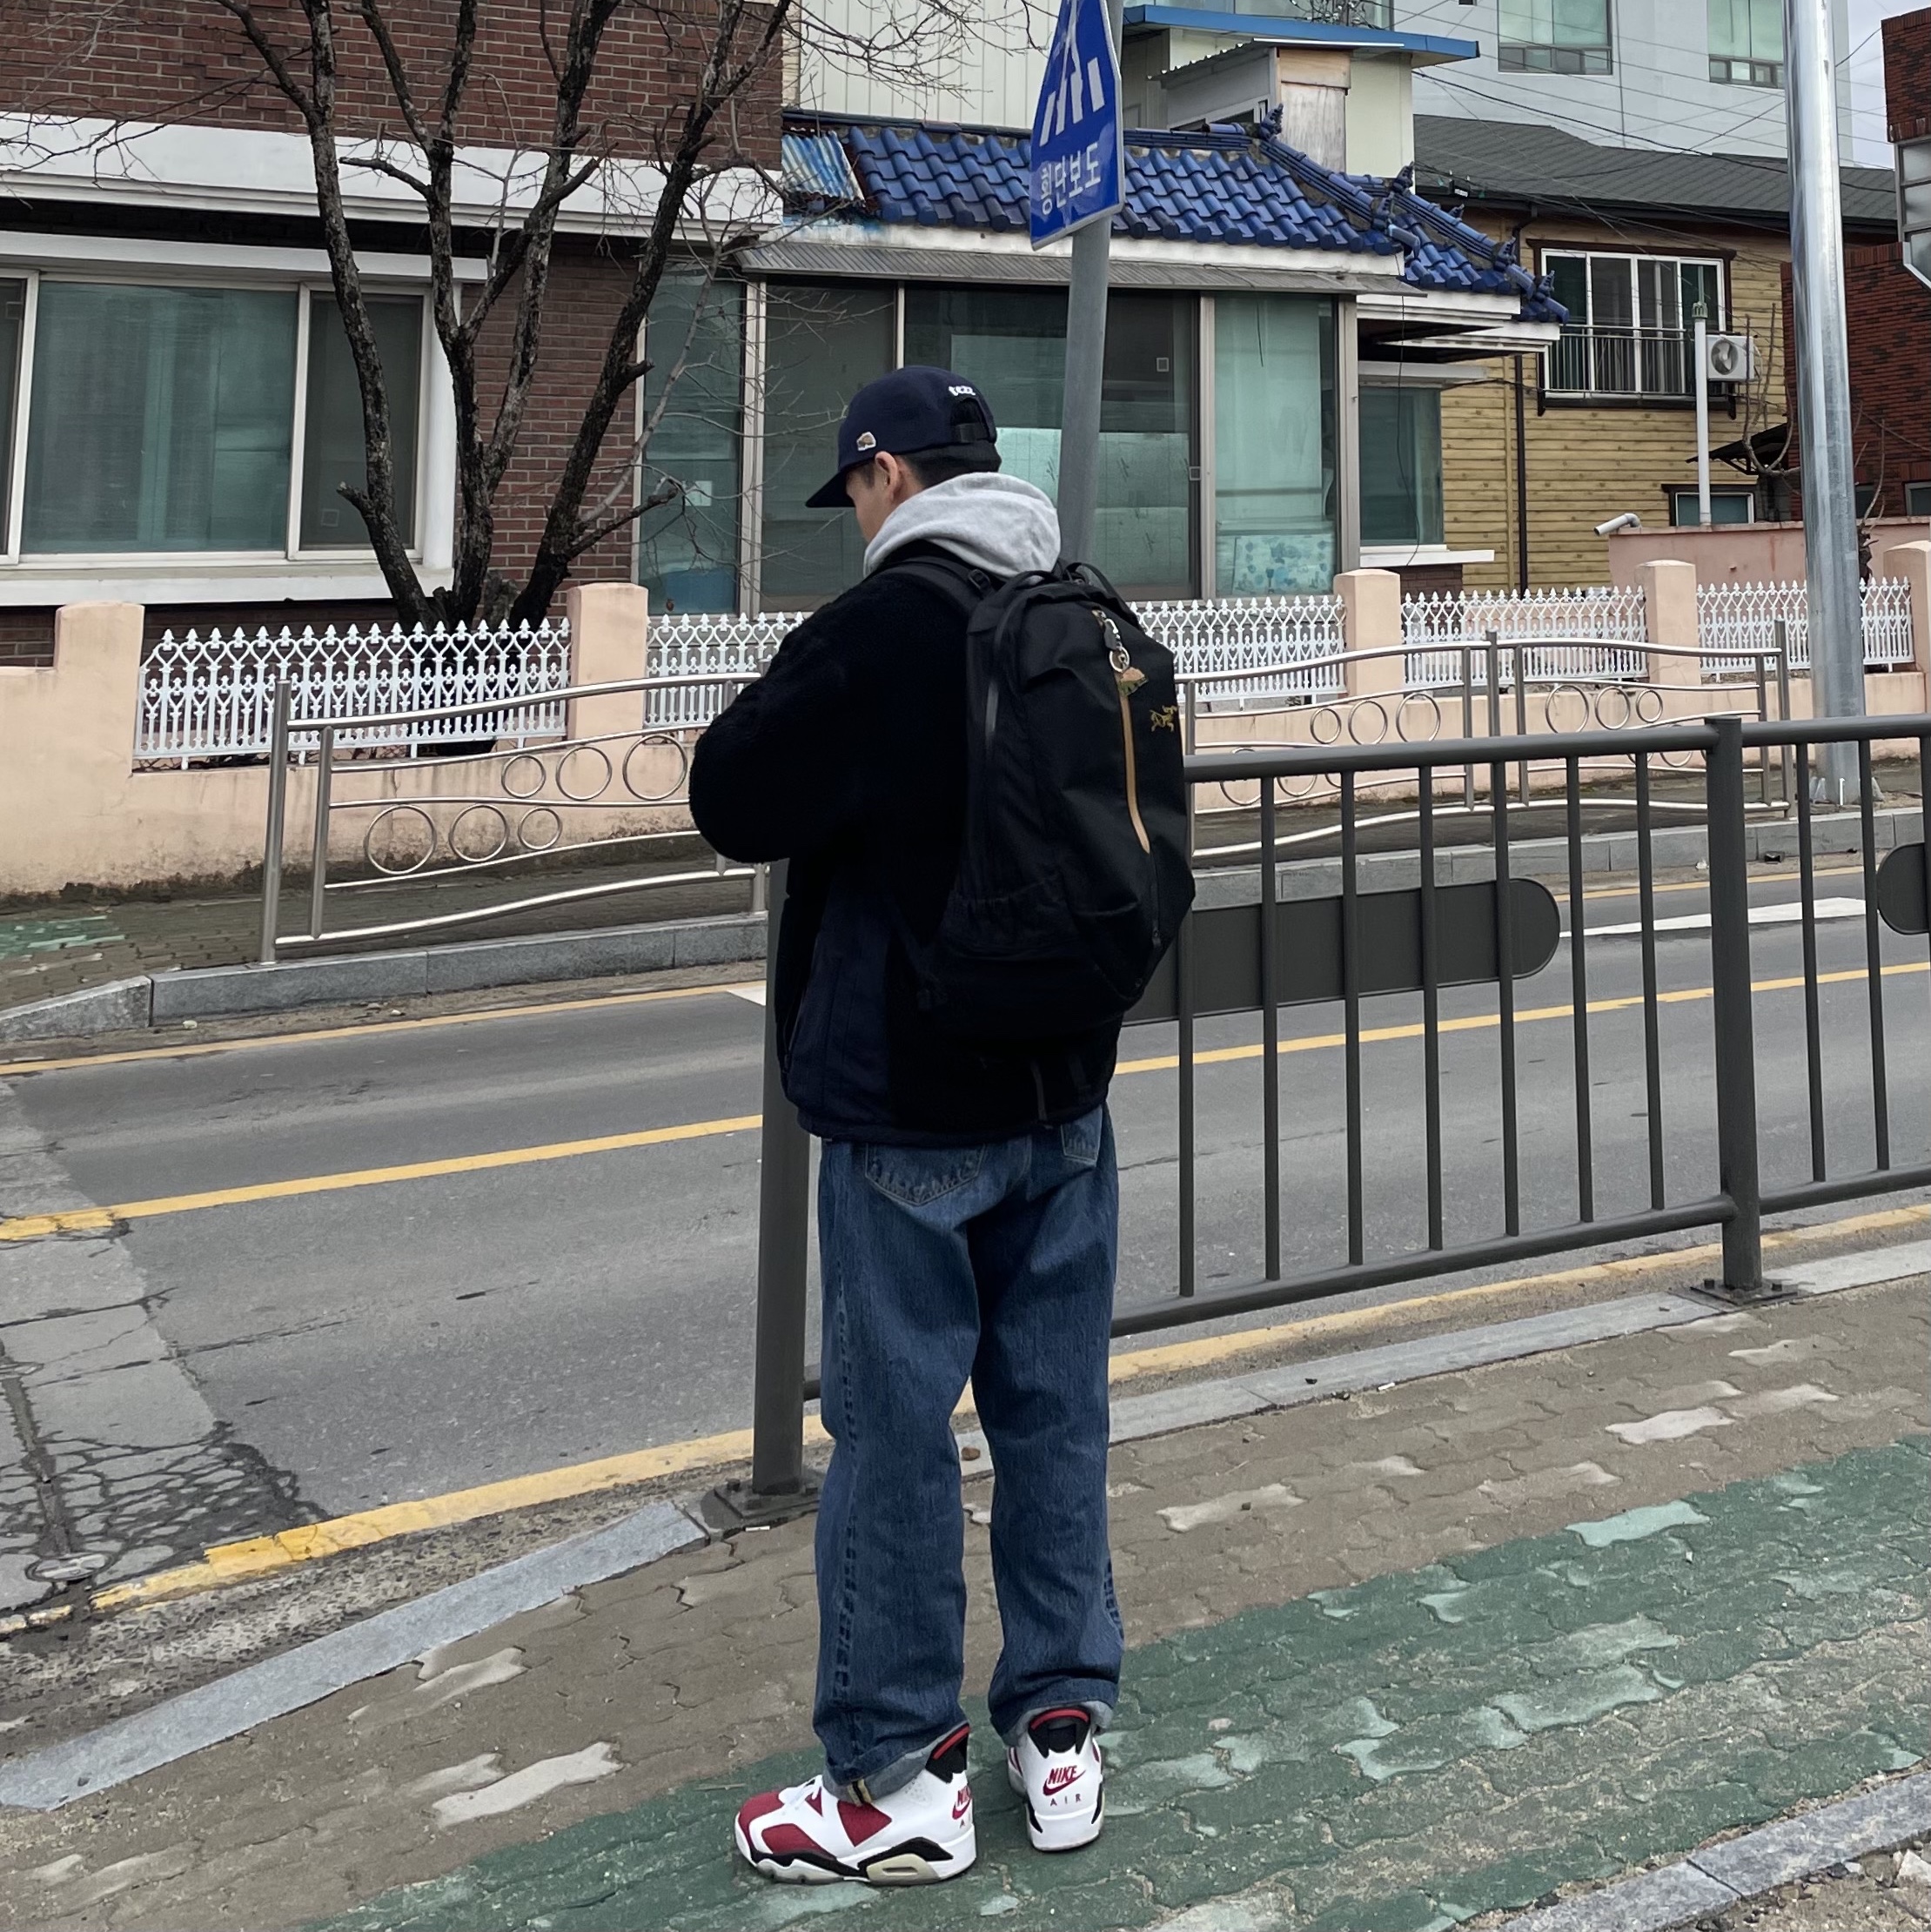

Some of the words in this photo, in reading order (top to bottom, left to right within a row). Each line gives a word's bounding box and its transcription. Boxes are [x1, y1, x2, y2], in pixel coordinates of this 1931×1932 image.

[1041, 142, 1101, 215] 횡단보도
[1048, 1765, 1077, 1785] NIKE
[1049, 1793, 1082, 1807] AIR
